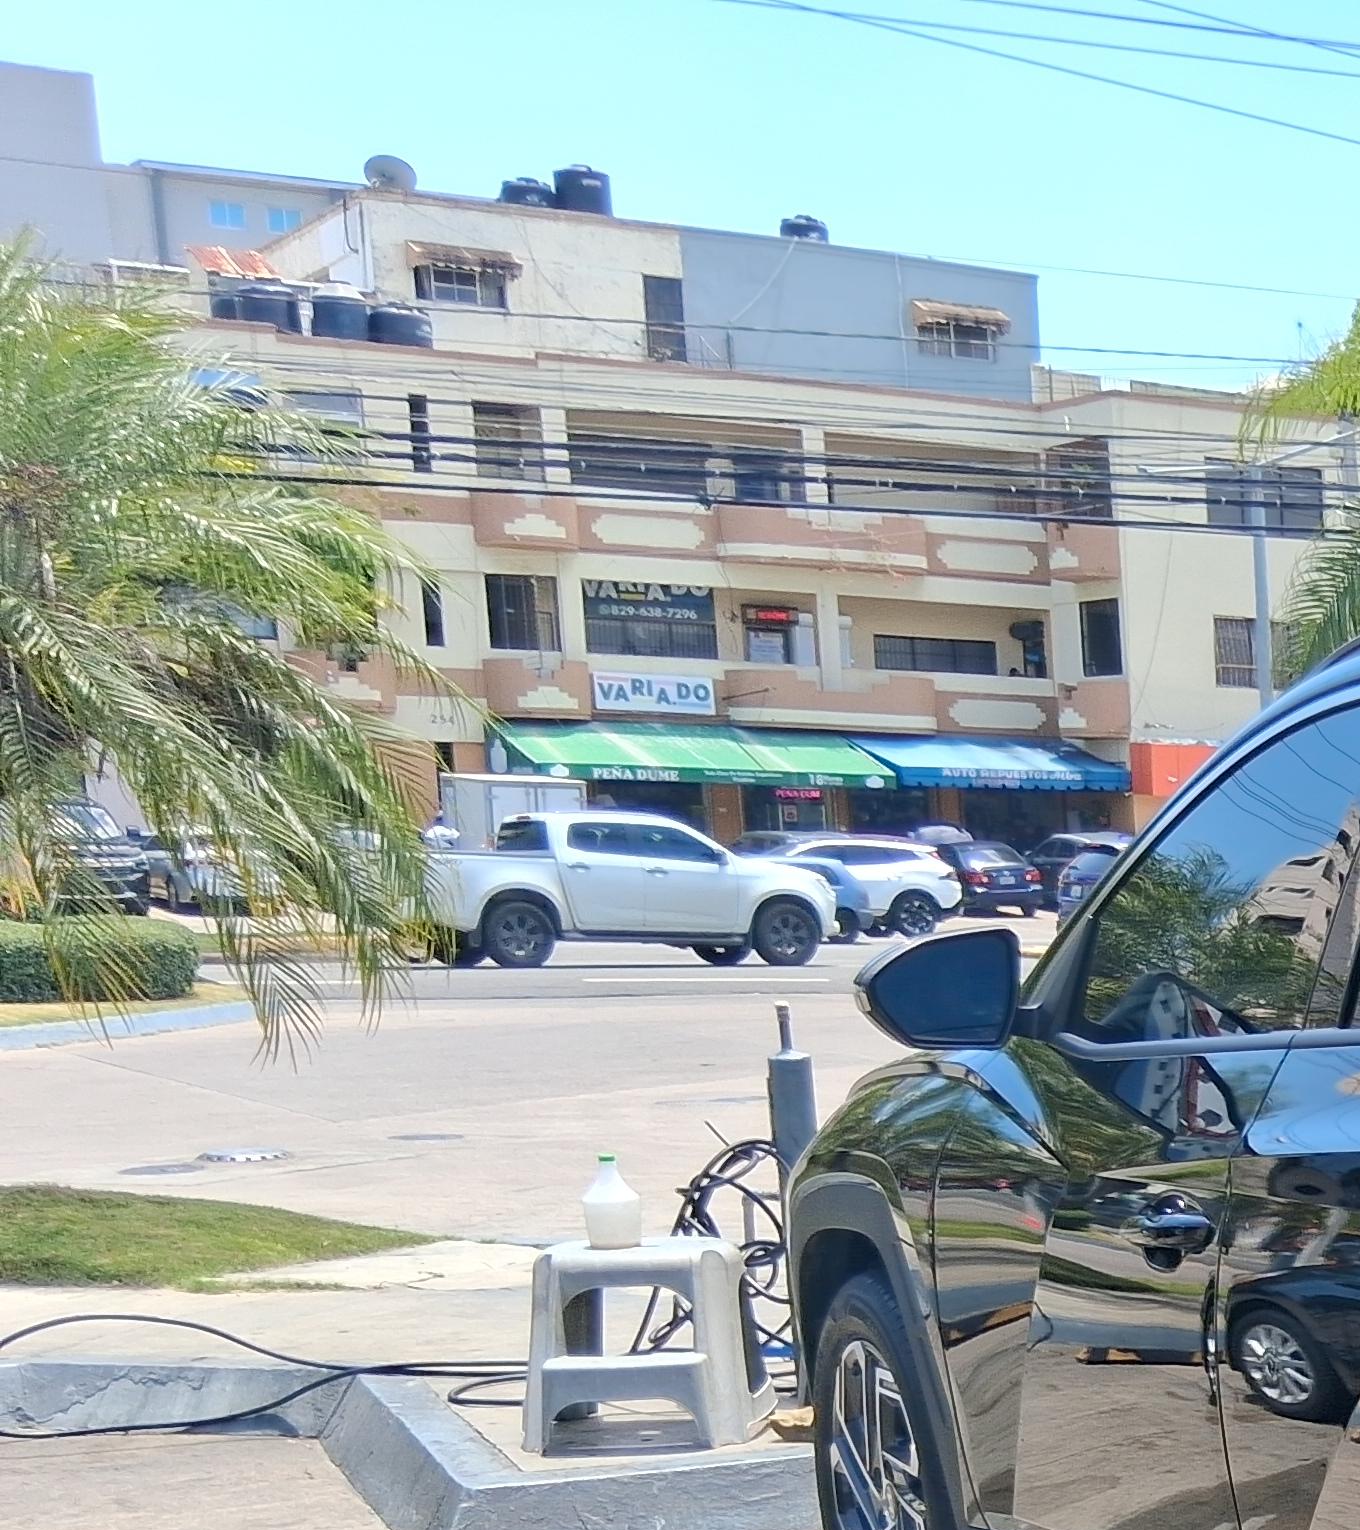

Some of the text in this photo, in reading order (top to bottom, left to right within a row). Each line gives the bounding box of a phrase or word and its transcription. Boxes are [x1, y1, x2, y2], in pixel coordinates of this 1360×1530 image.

[611, 605, 697, 619] 829-638-7296
[598, 678, 710, 704] VARIA.DO
[592, 765, 680, 782] PEÑA DUME
[943, 768, 976, 778] AUTO
[980, 769, 1047, 780] REPUESTOS
